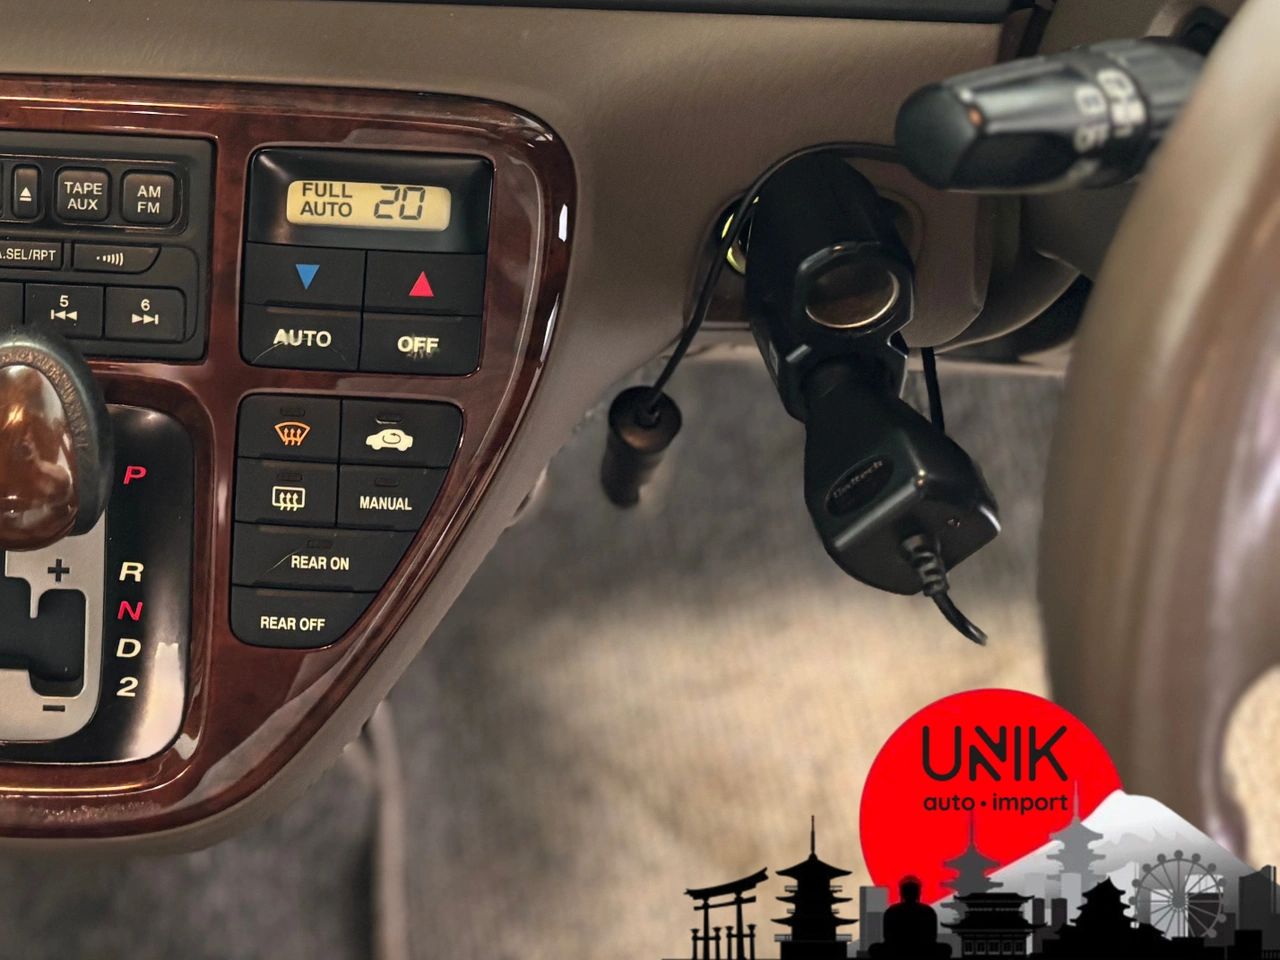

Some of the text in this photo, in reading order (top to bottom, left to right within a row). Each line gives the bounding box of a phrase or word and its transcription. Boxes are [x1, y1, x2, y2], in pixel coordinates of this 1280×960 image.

[64, 182, 102, 195] TAPE
[137, 186, 161, 198] AM
[302, 182, 353, 198] FULL
[67, 199, 98, 210] AUX
[137, 202, 160, 214] FM
[300, 202, 353, 217] AUTO
[374, 185, 425, 220] 20
[60, 295, 69, 308] 5
[141, 299, 150, 311] 6
[273, 328, 332, 347] AUTO
[397, 336, 439, 353] OFF
[123, 466, 147, 485] P
[359, 496, 412, 511] MANUAL
[291, 555, 350, 571] REAR ON
[119, 562, 145, 582] R
[117, 601, 144, 621] N
[260, 616, 325, 631] REAR OFF
[116, 638, 142, 658] D
[116, 678, 138, 698] 2
